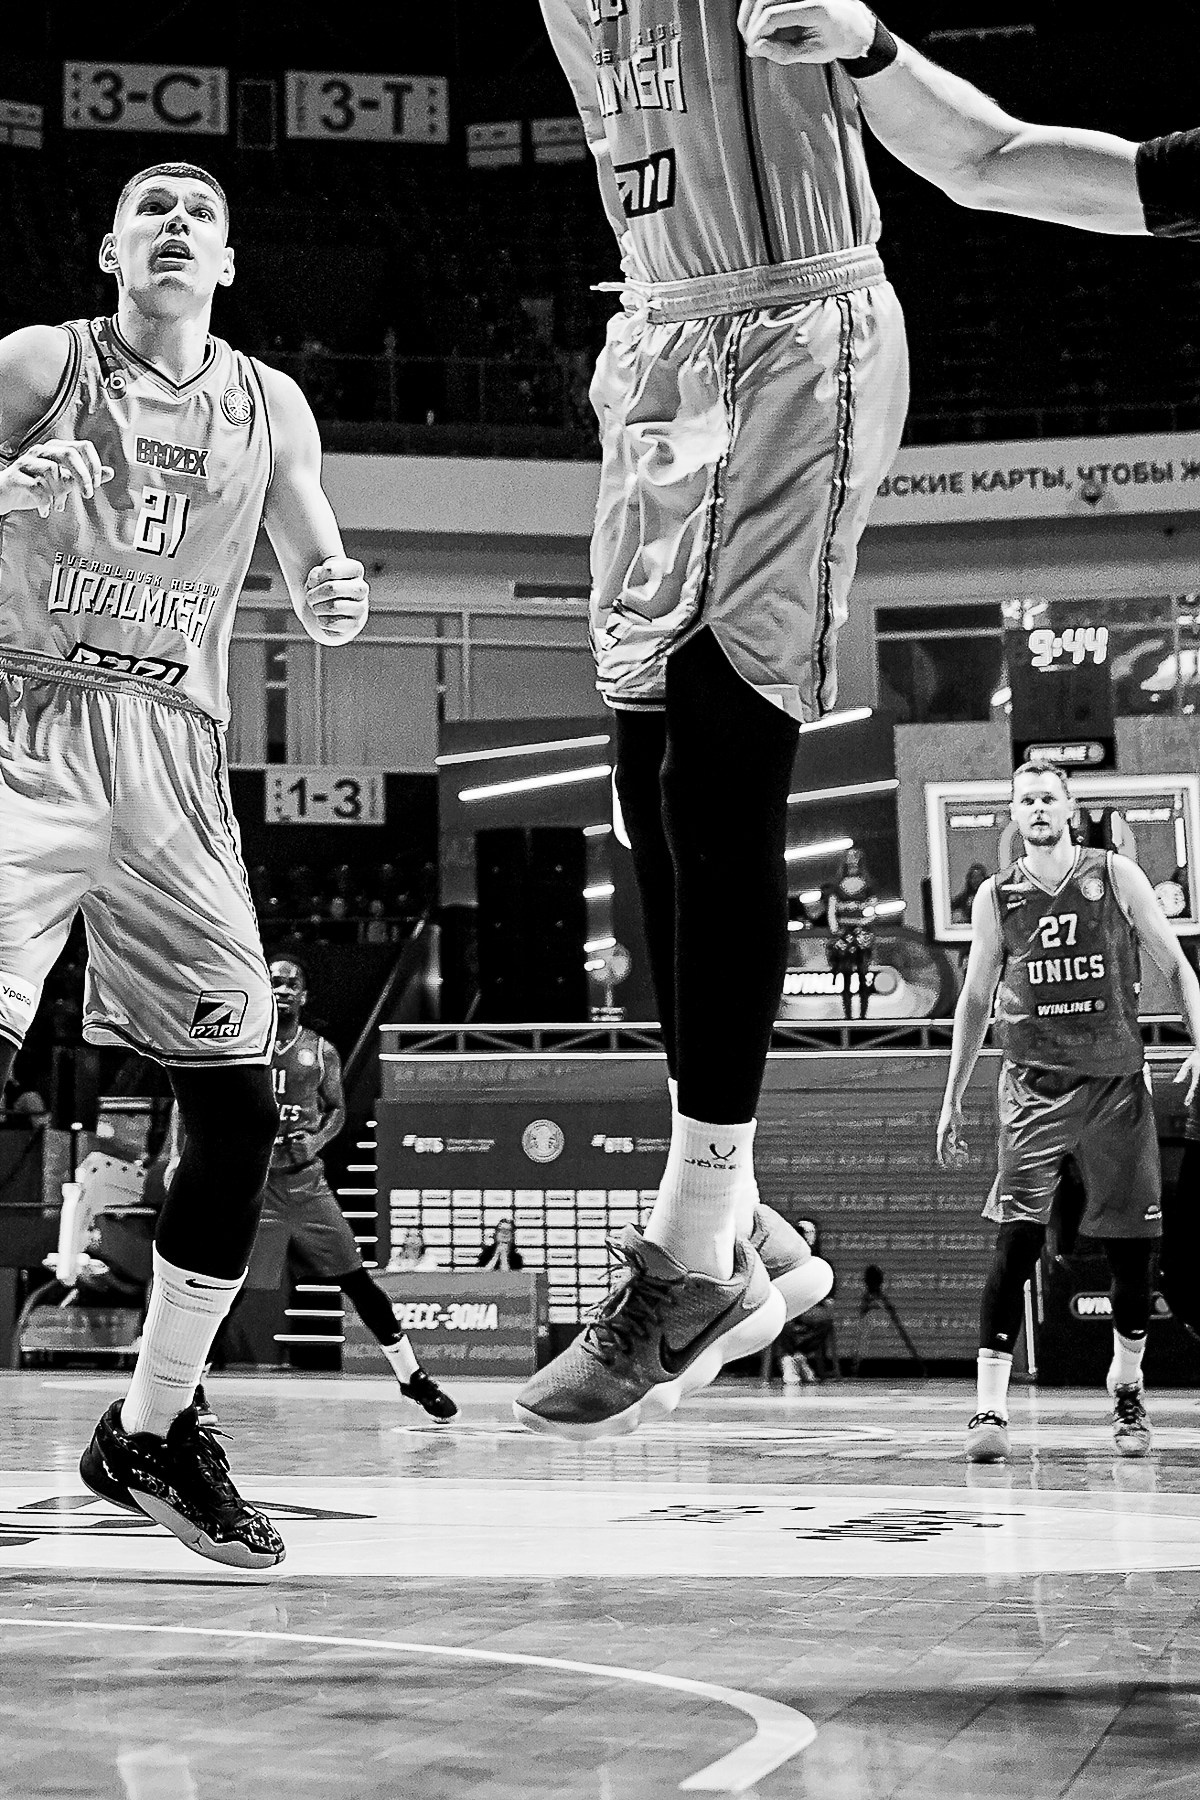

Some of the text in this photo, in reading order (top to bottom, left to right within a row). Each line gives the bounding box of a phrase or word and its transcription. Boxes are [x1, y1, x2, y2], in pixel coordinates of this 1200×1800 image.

[136, 436, 209, 476] BROZEX
[133, 485, 190, 559] 21
[54, 551, 163, 587] SVERDLOVSK
[47, 563, 217, 649] URALMASH
[1028, 626, 1109, 667] 9:44
[288, 778, 361, 818] 1-3
[1038, 913, 1078, 949] 27
[1026, 954, 1105, 984] UNICS
[1037, 999, 1093, 1016] WINLINE
